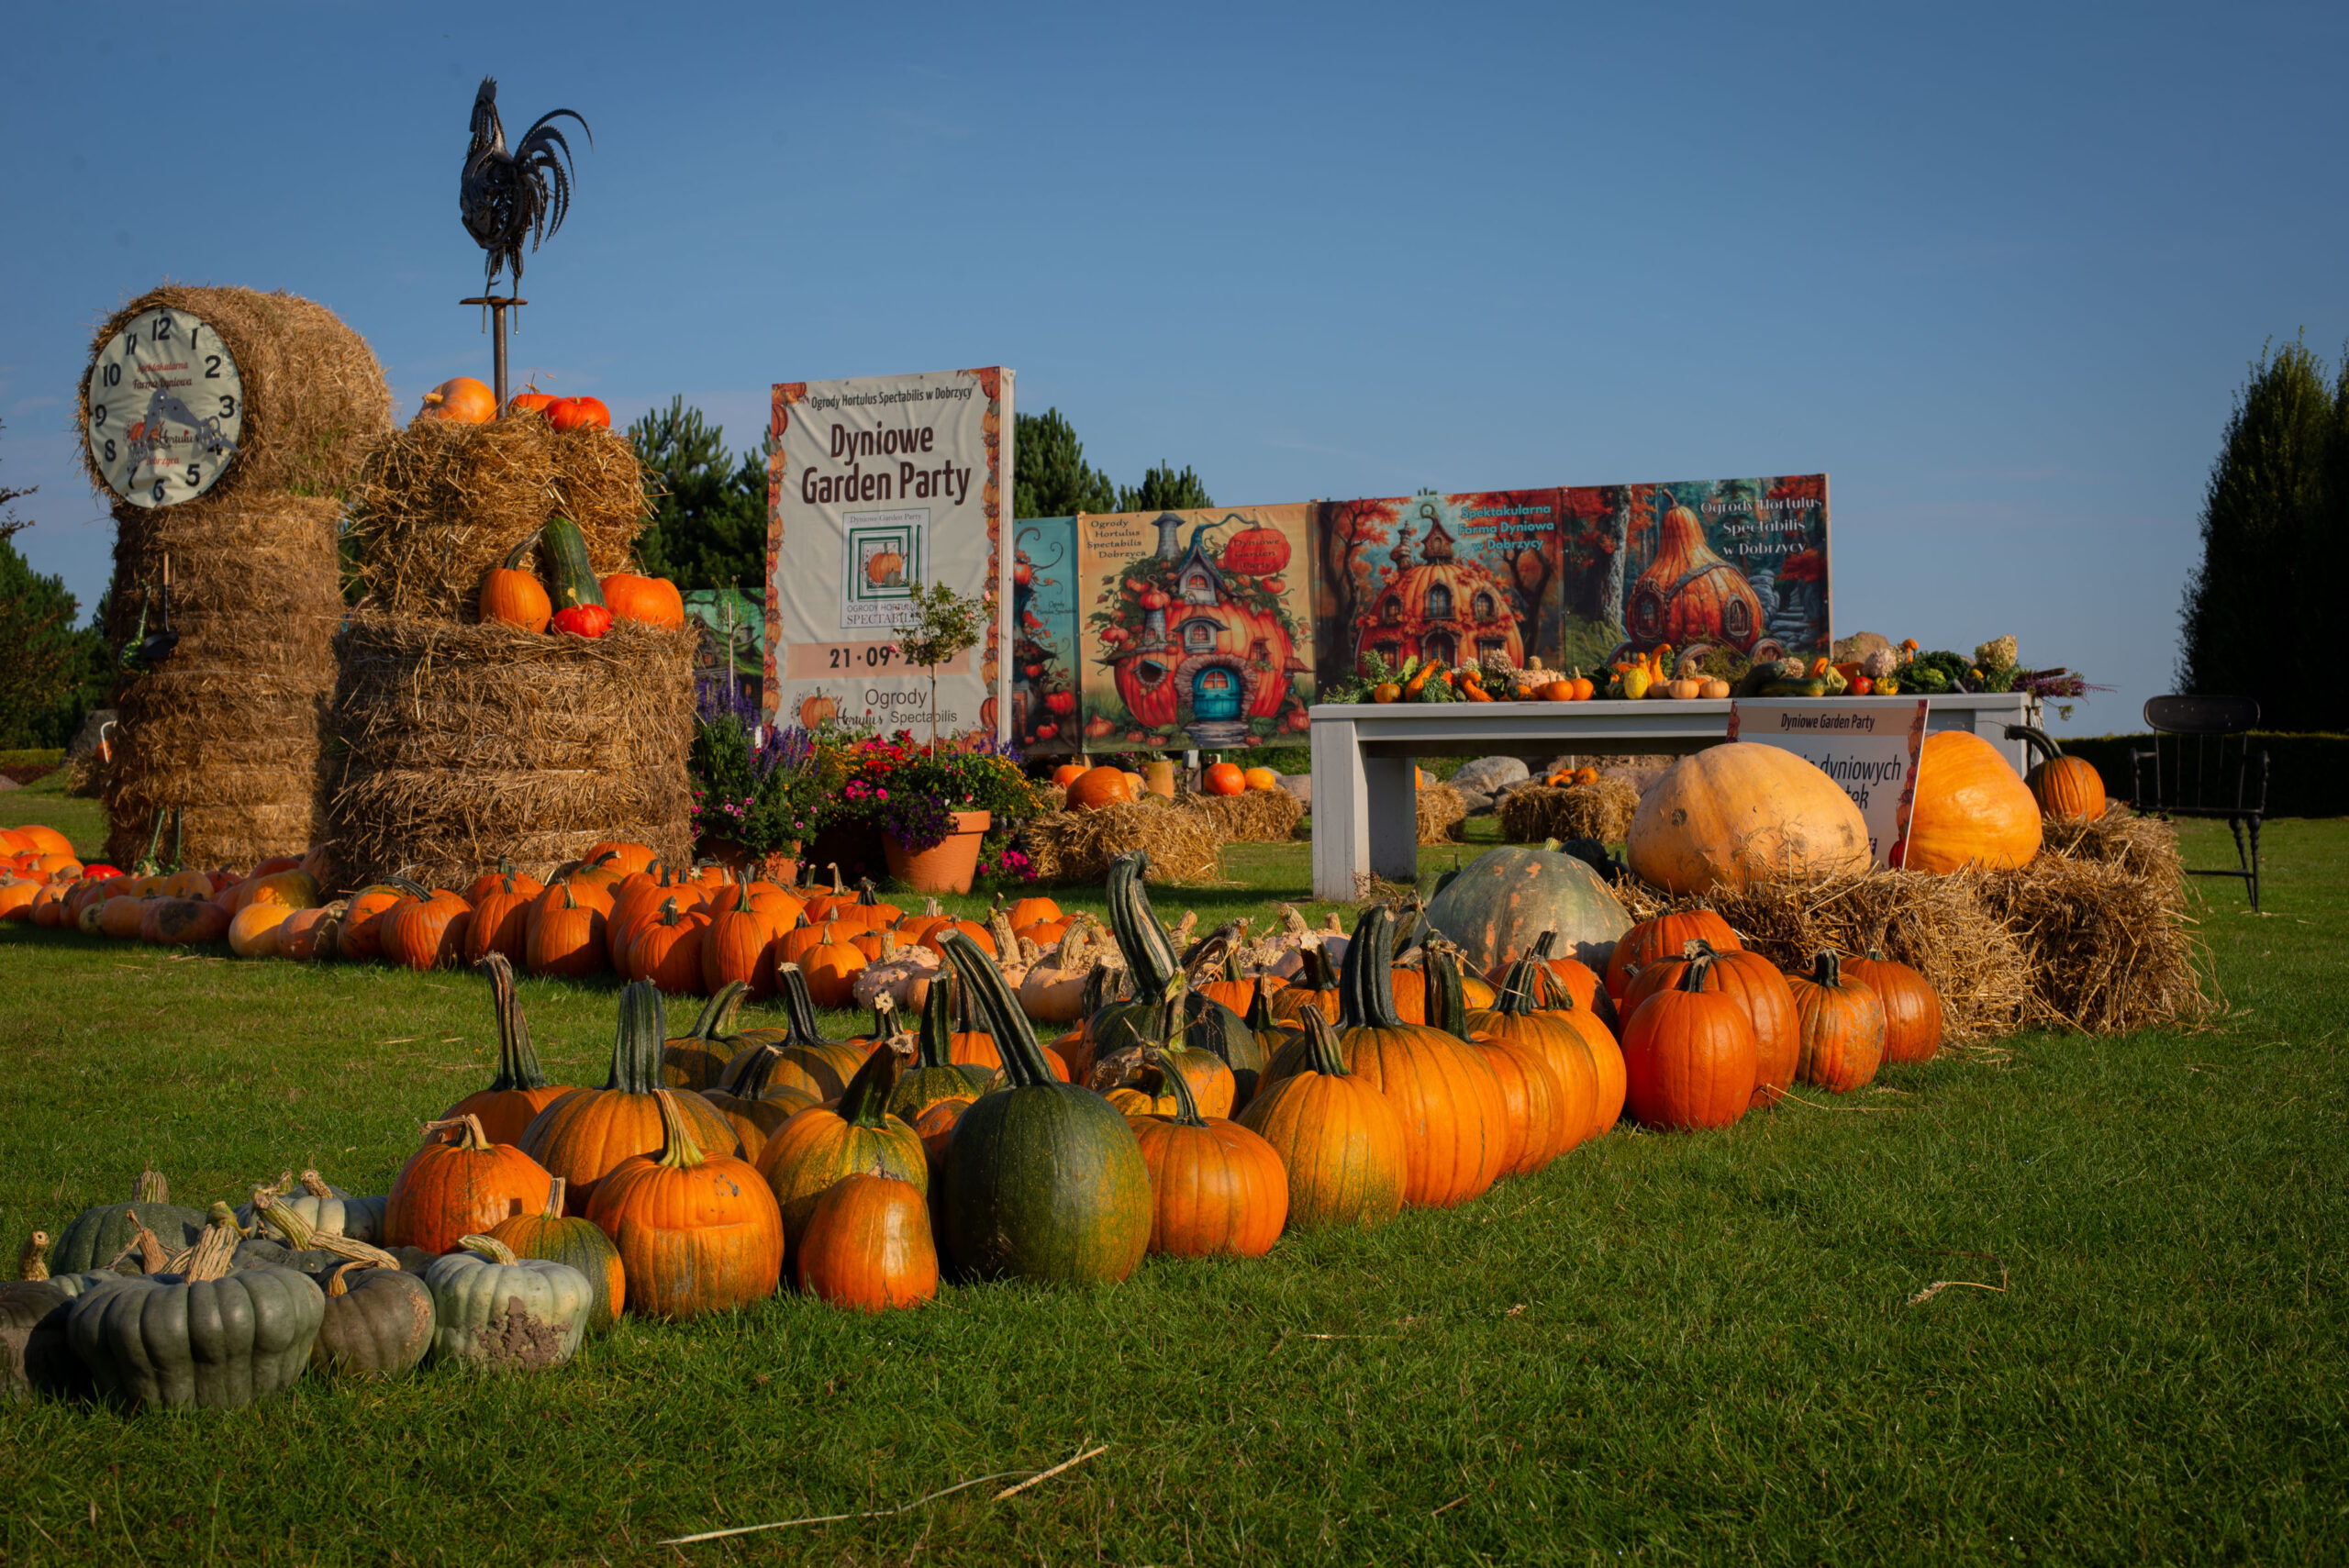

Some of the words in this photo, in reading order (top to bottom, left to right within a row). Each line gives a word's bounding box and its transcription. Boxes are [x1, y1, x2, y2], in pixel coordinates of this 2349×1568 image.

[151, 317, 172, 341] 12
[191, 328, 198, 350] 1
[126, 333, 137, 356] 11
[103, 362, 121, 387] 10
[205, 354, 221, 379] 2
[218, 395, 235, 418] 3
[811, 395, 841, 411] Ogrody
[841, 392, 877, 406] Hortulus
[878, 389, 924, 406] Spectabilis
[925, 391, 933, 400] w
[935, 386, 973, 400] Dobrzycy
[95, 404, 107, 428] 9
[104, 439, 117, 462] 8
[830, 420, 934, 466] Dyniowe
[185, 463, 200, 487] 5
[802, 462, 892, 505] Garden
[899, 460, 972, 506] Party
[152, 478, 165, 502] 6
[904, 512, 921, 521] Party
[1461, 504, 1551, 521] Spektakularna
[1700, 499, 1753, 516] Ogrody
[1759, 496, 1822, 510] Hortulus
[1090, 518, 1129, 529] Ogrody
[1095, 528, 1141, 538] Hortulus
[1458, 523, 1497, 536] Farma
[1500, 520, 1554, 536] Dyniowa
[1723, 518, 1806, 537] Spectabilis
[1087, 539, 1142, 550] Spectabilis
[1099, 550, 1146, 559] Dobrzyca
[1472, 542, 1485, 550] w
[1487, 538, 1543, 550] Dobrzycy
[1723, 547, 1734, 555] w
[1739, 542, 1806, 555] Dobrzycy
[847, 604, 878, 613] OGRODY
[864, 688, 928, 709] Ogrody
[1781, 713, 1818, 731] Dyniowe
[1820, 714, 1850, 728] Garden
[1851, 714, 1875, 732] Party
[1820, 753, 1901, 786] dyniowych
